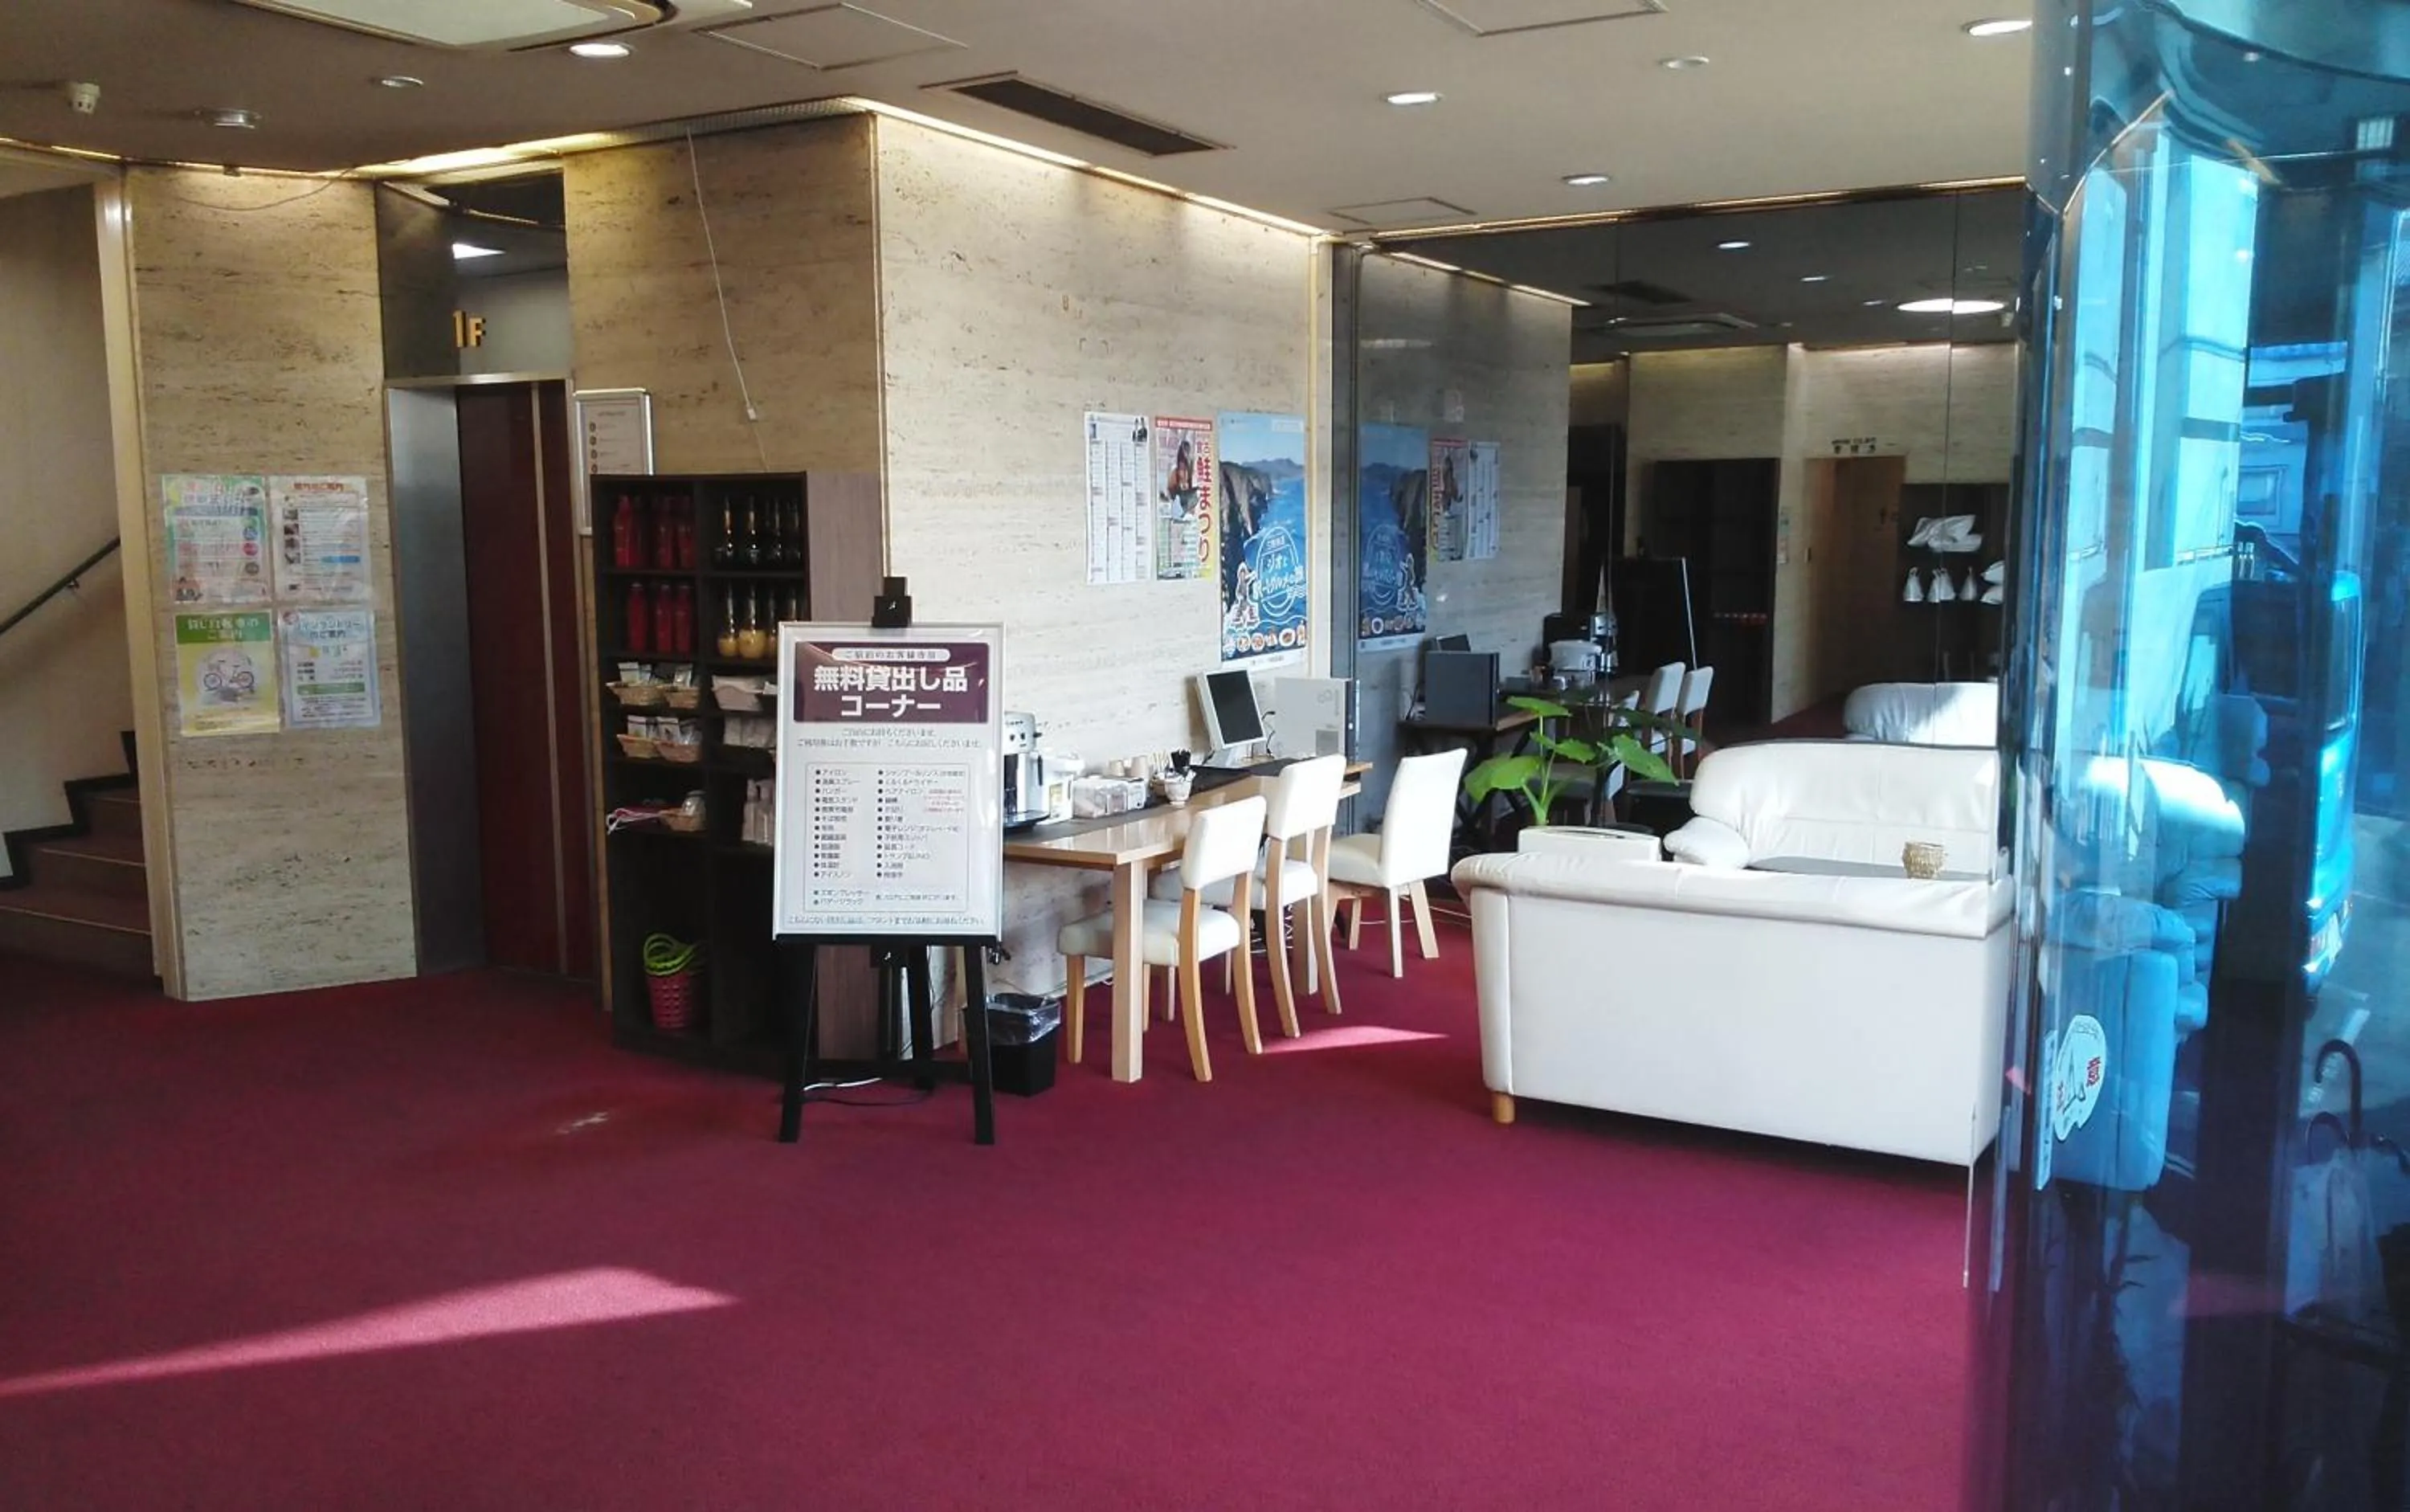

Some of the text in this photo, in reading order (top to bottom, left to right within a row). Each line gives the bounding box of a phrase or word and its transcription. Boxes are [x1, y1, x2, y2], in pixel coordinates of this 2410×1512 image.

[453, 310, 486, 347] 1F
[814, 665, 968, 692] 無料貸出し品
[840, 693, 942, 718] コーナー
